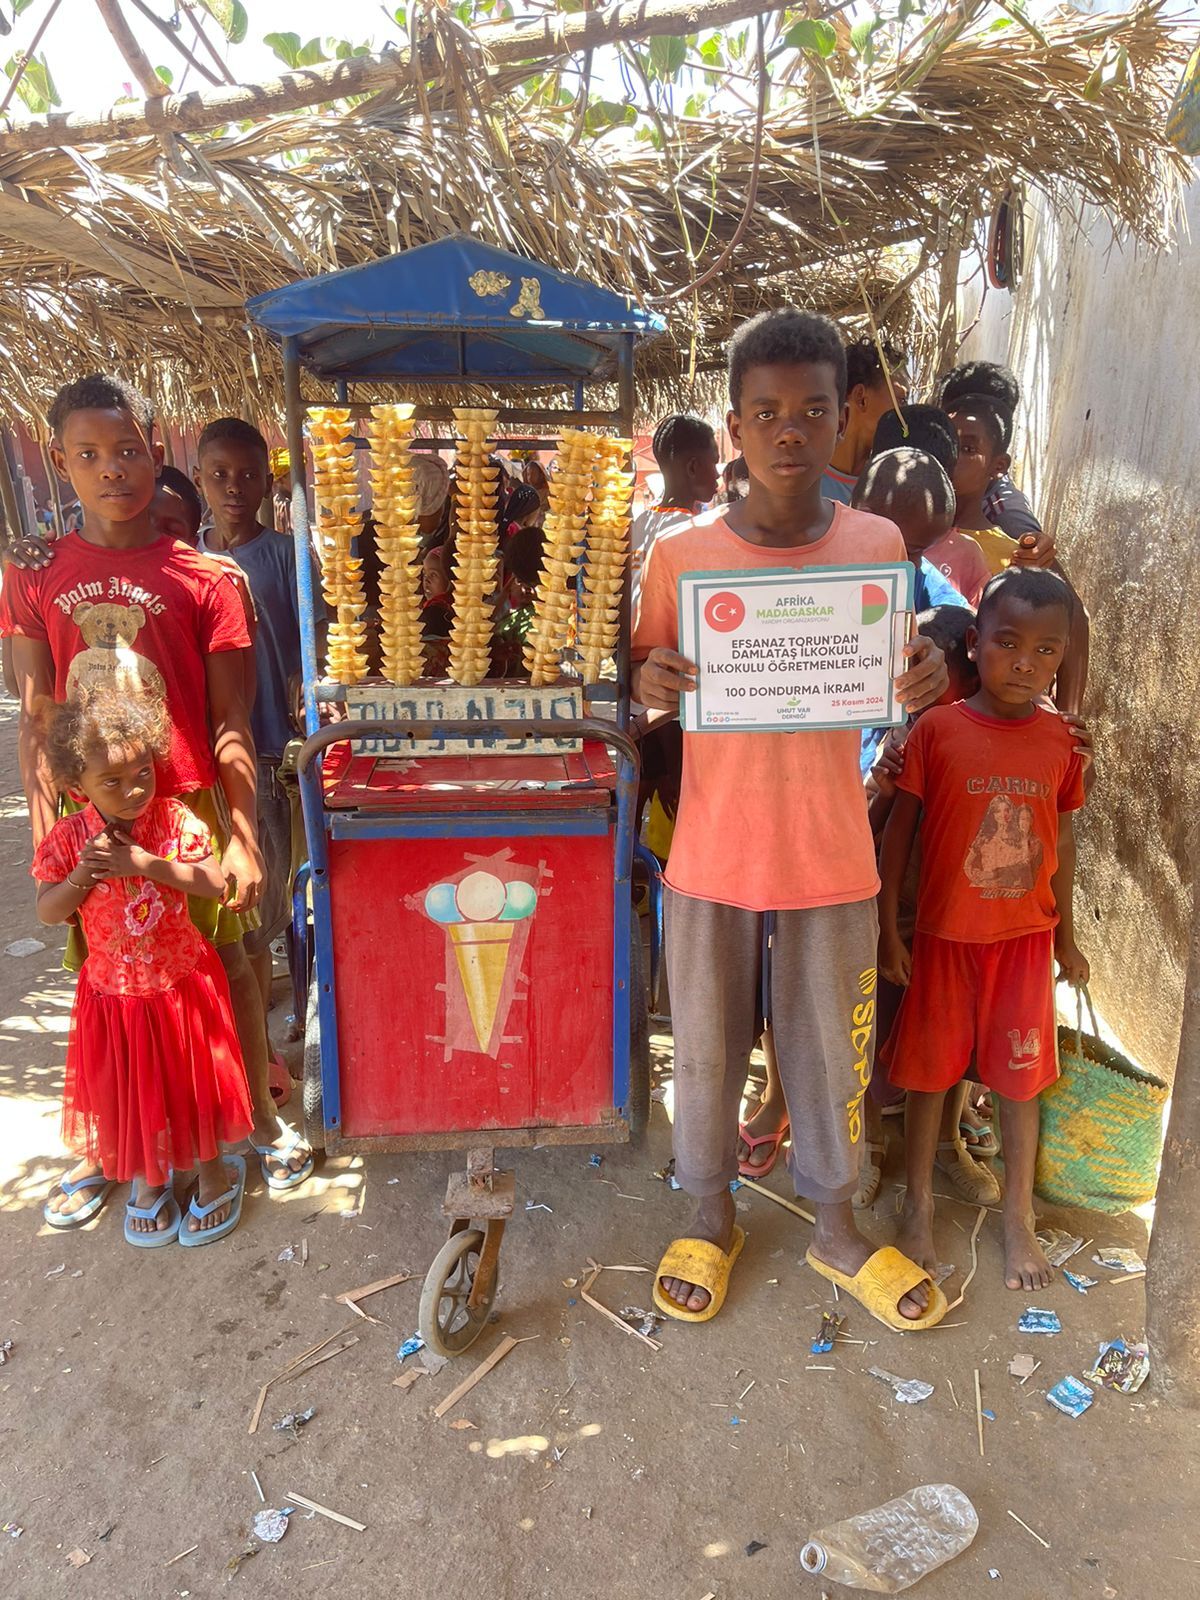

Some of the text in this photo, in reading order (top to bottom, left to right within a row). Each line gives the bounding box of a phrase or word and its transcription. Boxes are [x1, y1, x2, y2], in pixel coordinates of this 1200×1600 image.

[53, 576, 167, 616] Palm Angels
[775, 594, 815, 607] AFRİKA
[756, 606, 834, 618] MADAGASKAR
[731, 633, 859, 648] EFSANAZ TORUN'DAN
[732, 648, 797, 660] DAMLATAŞ
[707, 654, 882, 673] İLKOKULU ÖĞRETMENLER İÇİN
[725, 682, 864, 697] 100 DONDURMA İKRAMI
[866, 696, 884, 704] 2024
